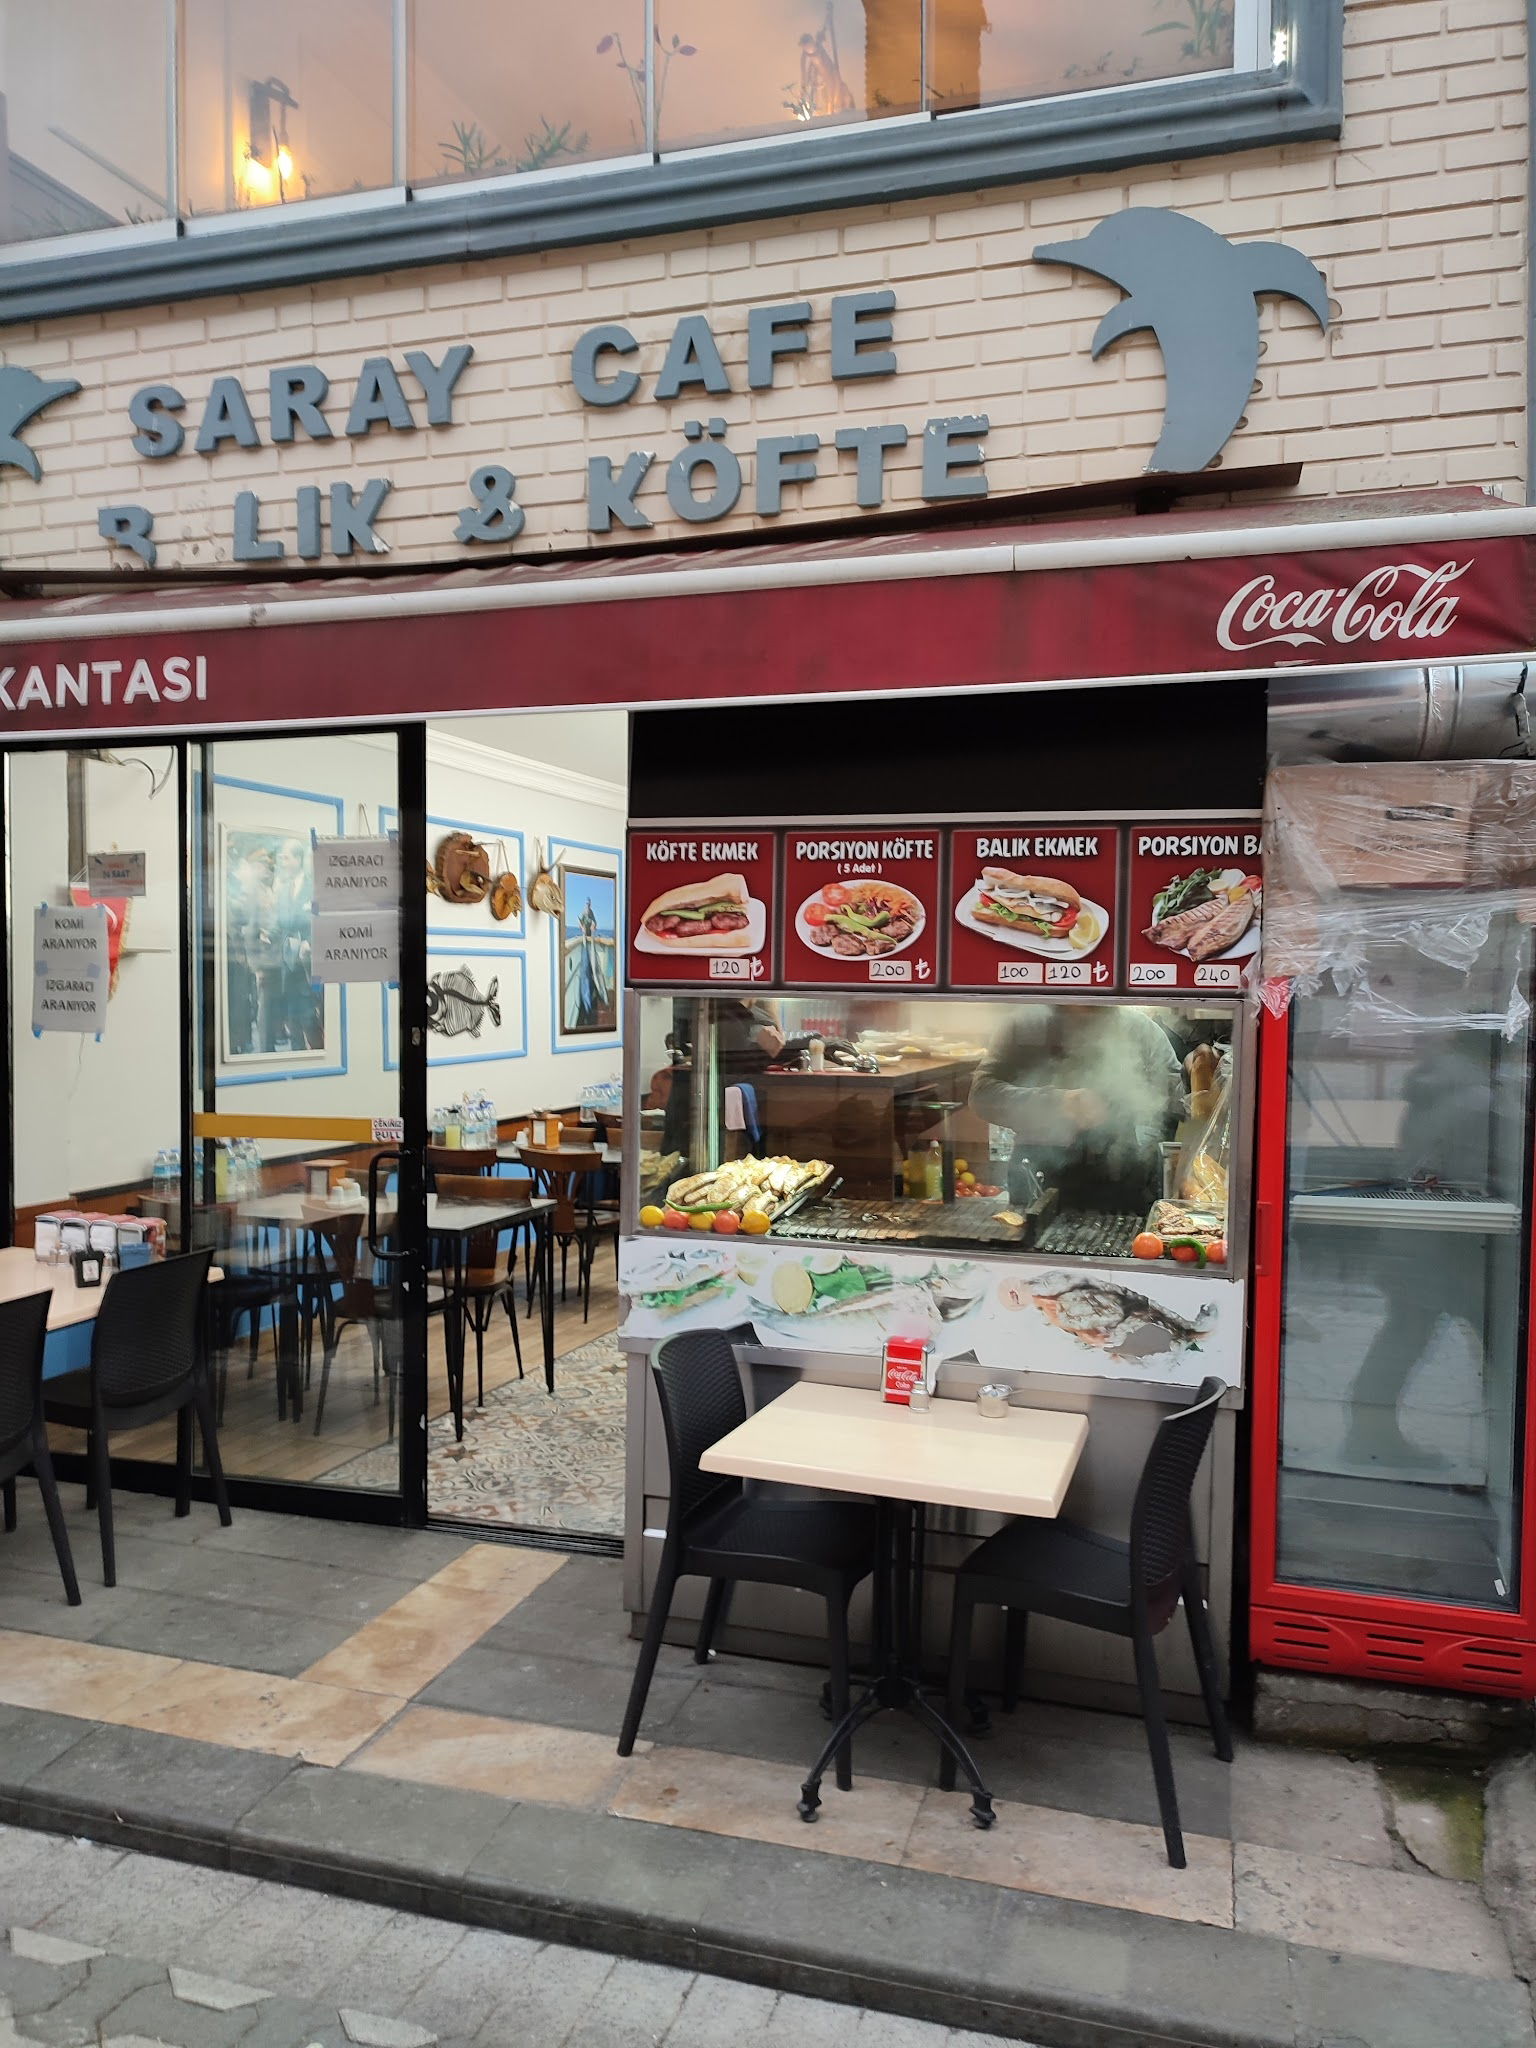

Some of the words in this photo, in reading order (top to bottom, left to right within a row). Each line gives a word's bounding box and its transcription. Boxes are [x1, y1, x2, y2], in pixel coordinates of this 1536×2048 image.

[128, 345, 474, 459] SARAY
[571, 290, 897, 408] CAFE
[454, 464, 525, 545] &
[588, 413, 989, 534] KÖFTE
[1216, 558, 1475, 651] Coca-Cola
[0, 655, 207, 711] KANTASI
[646, 840, 698, 862] KÖFTE
[701, 842, 759, 861] EKMEK
[796, 840, 879, 860] PORSIYON
[882, 837, 933, 860] KÖFTE
[976, 838, 1030, 858] BALIK
[1034, 837, 1099, 857] EKMEK
[1138, 835, 1238, 857] PORSIYON
[325, 876, 388, 888] ARANIYOR
[42, 937, 97, 950] ARANIYOR
[324, 947, 388, 960] ARANIYOR
[712, 960, 740, 975] 120
[870, 962, 905, 977] 200
[1000, 965, 1029, 979] 100
[1049, 965, 1081, 979] 120
[1131, 966, 1166, 982] 200
[1197, 967, 1230, 983] 240
[41, 999, 96, 1013] ARANIYOR
